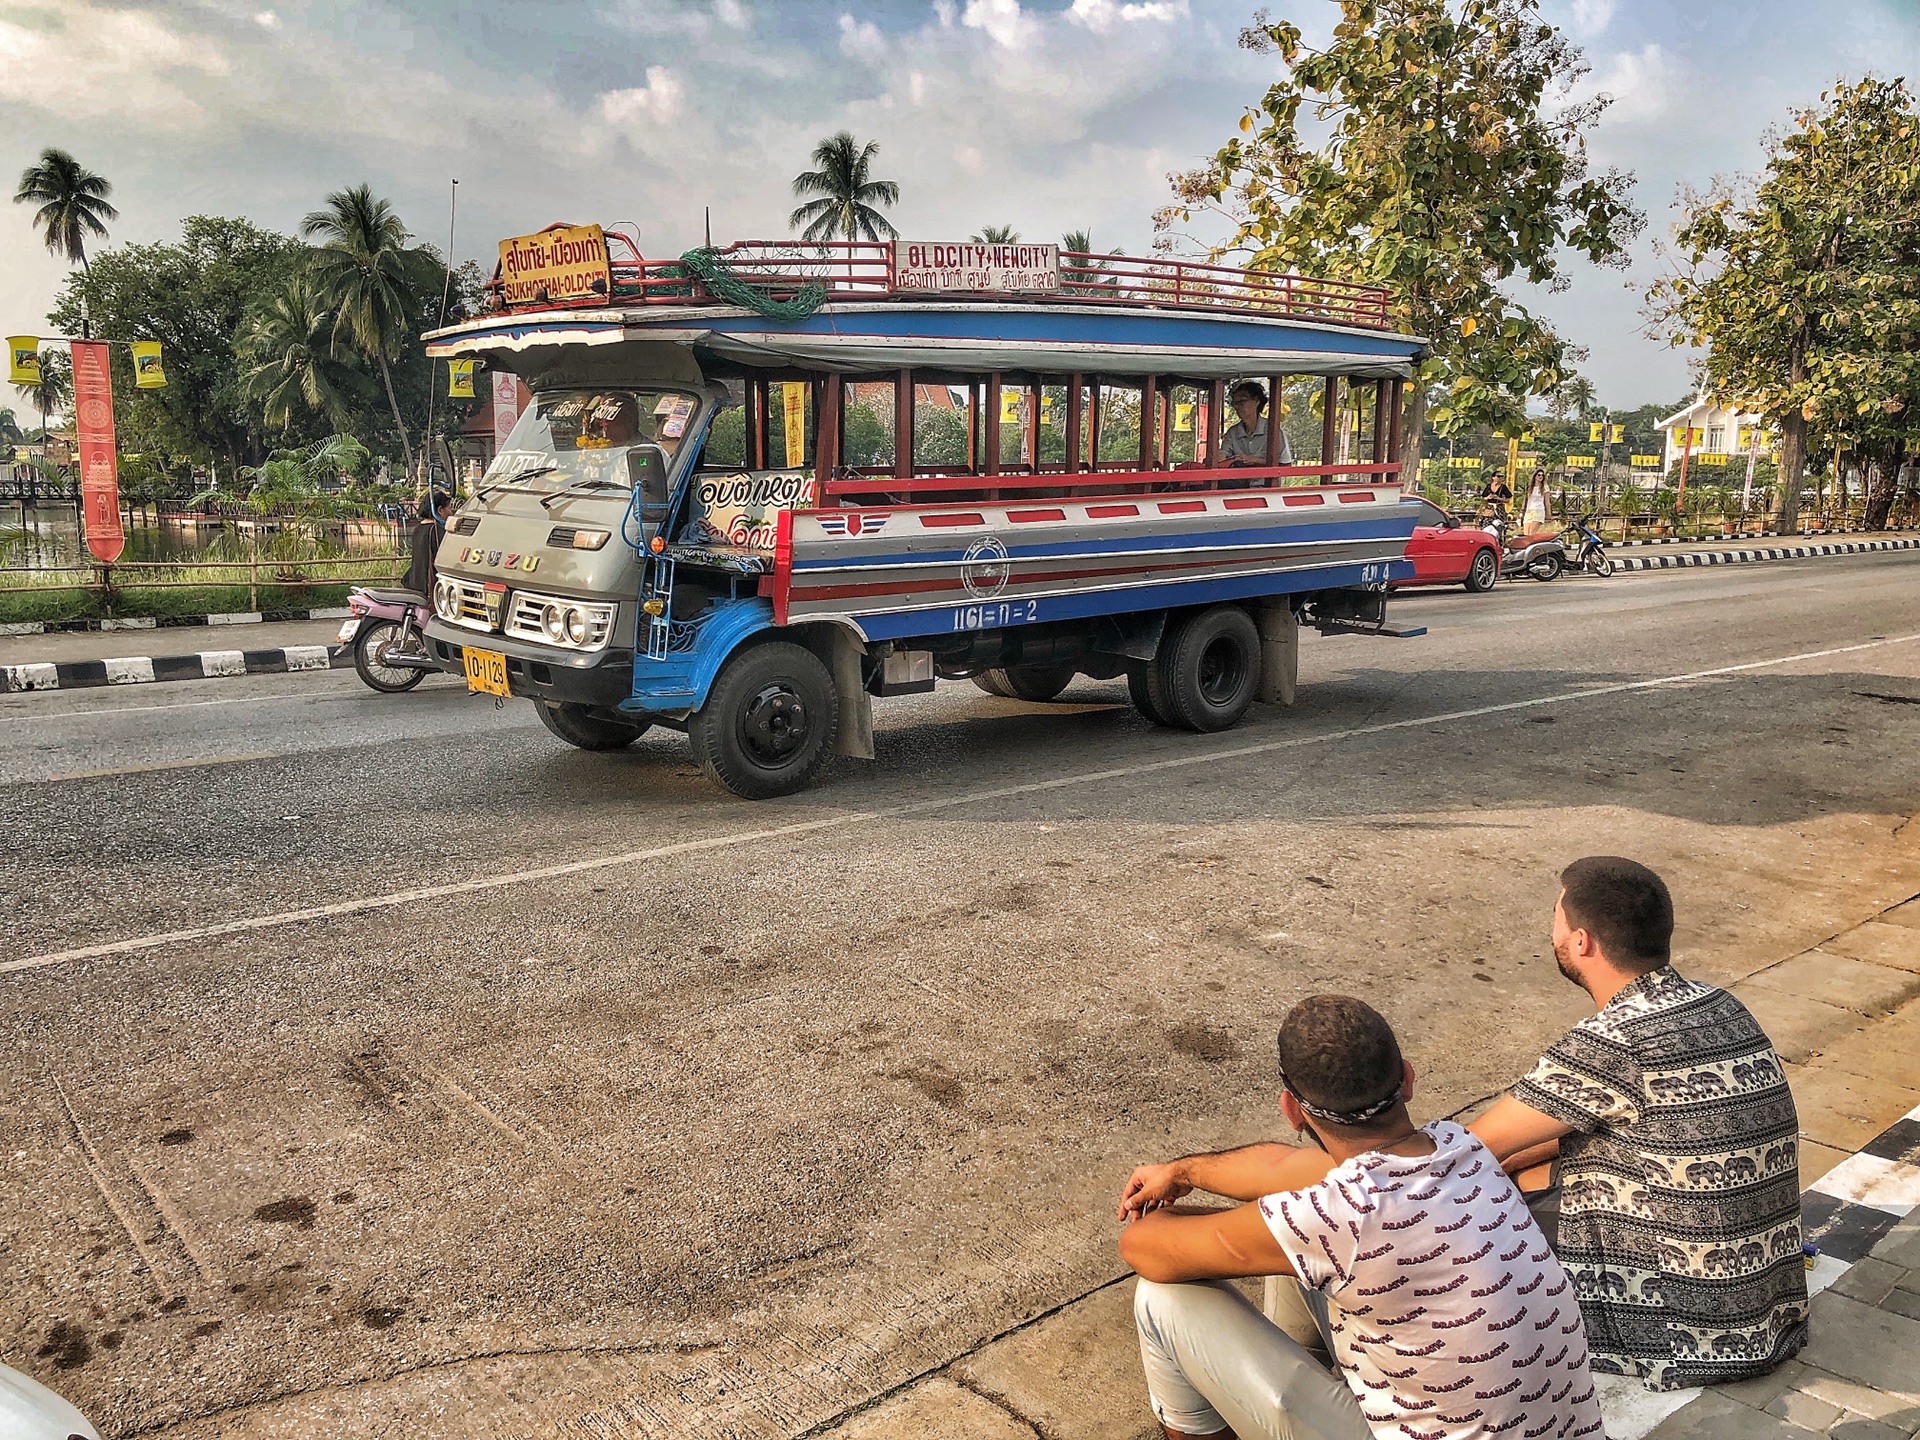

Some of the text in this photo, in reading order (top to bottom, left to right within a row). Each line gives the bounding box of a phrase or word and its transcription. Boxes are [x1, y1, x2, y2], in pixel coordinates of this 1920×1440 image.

[908, 245, 985, 268] OLDCITY
[459, 547, 541, 573] ISUZU
[467, 655, 504, 685] 10-1129
[1381, 1210, 1429, 1231] DRAMATIC
[1434, 1213, 1473, 1234] DRAMATIC
[1396, 1242, 1451, 1266] DRAMATIC
[1452, 1240, 1495, 1266] DRAMATIC
[1357, 1275, 1410, 1296] DRAMATIC
[1413, 1274, 1469, 1298] DRAMATIC
[1470, 1271, 1514, 1298] DRAMATIC
[1376, 1306, 1428, 1326] DRAMATIC
[1431, 1307, 1487, 1330] DRAMATIC
[1487, 1305, 1528, 1332] DRAMATIC
[1395, 1339, 1447, 1357] DRAMATIC
[1457, 1341, 1510, 1364] DRAMATIC
[1422, 1375, 1475, 1393] DRAMATIC
[1474, 1377, 1523, 1400] DRAMATIC
[1435, 1408, 1484, 1424] DRAMATIC
[1482, 1411, 1529, 1434] DRAMATIC
